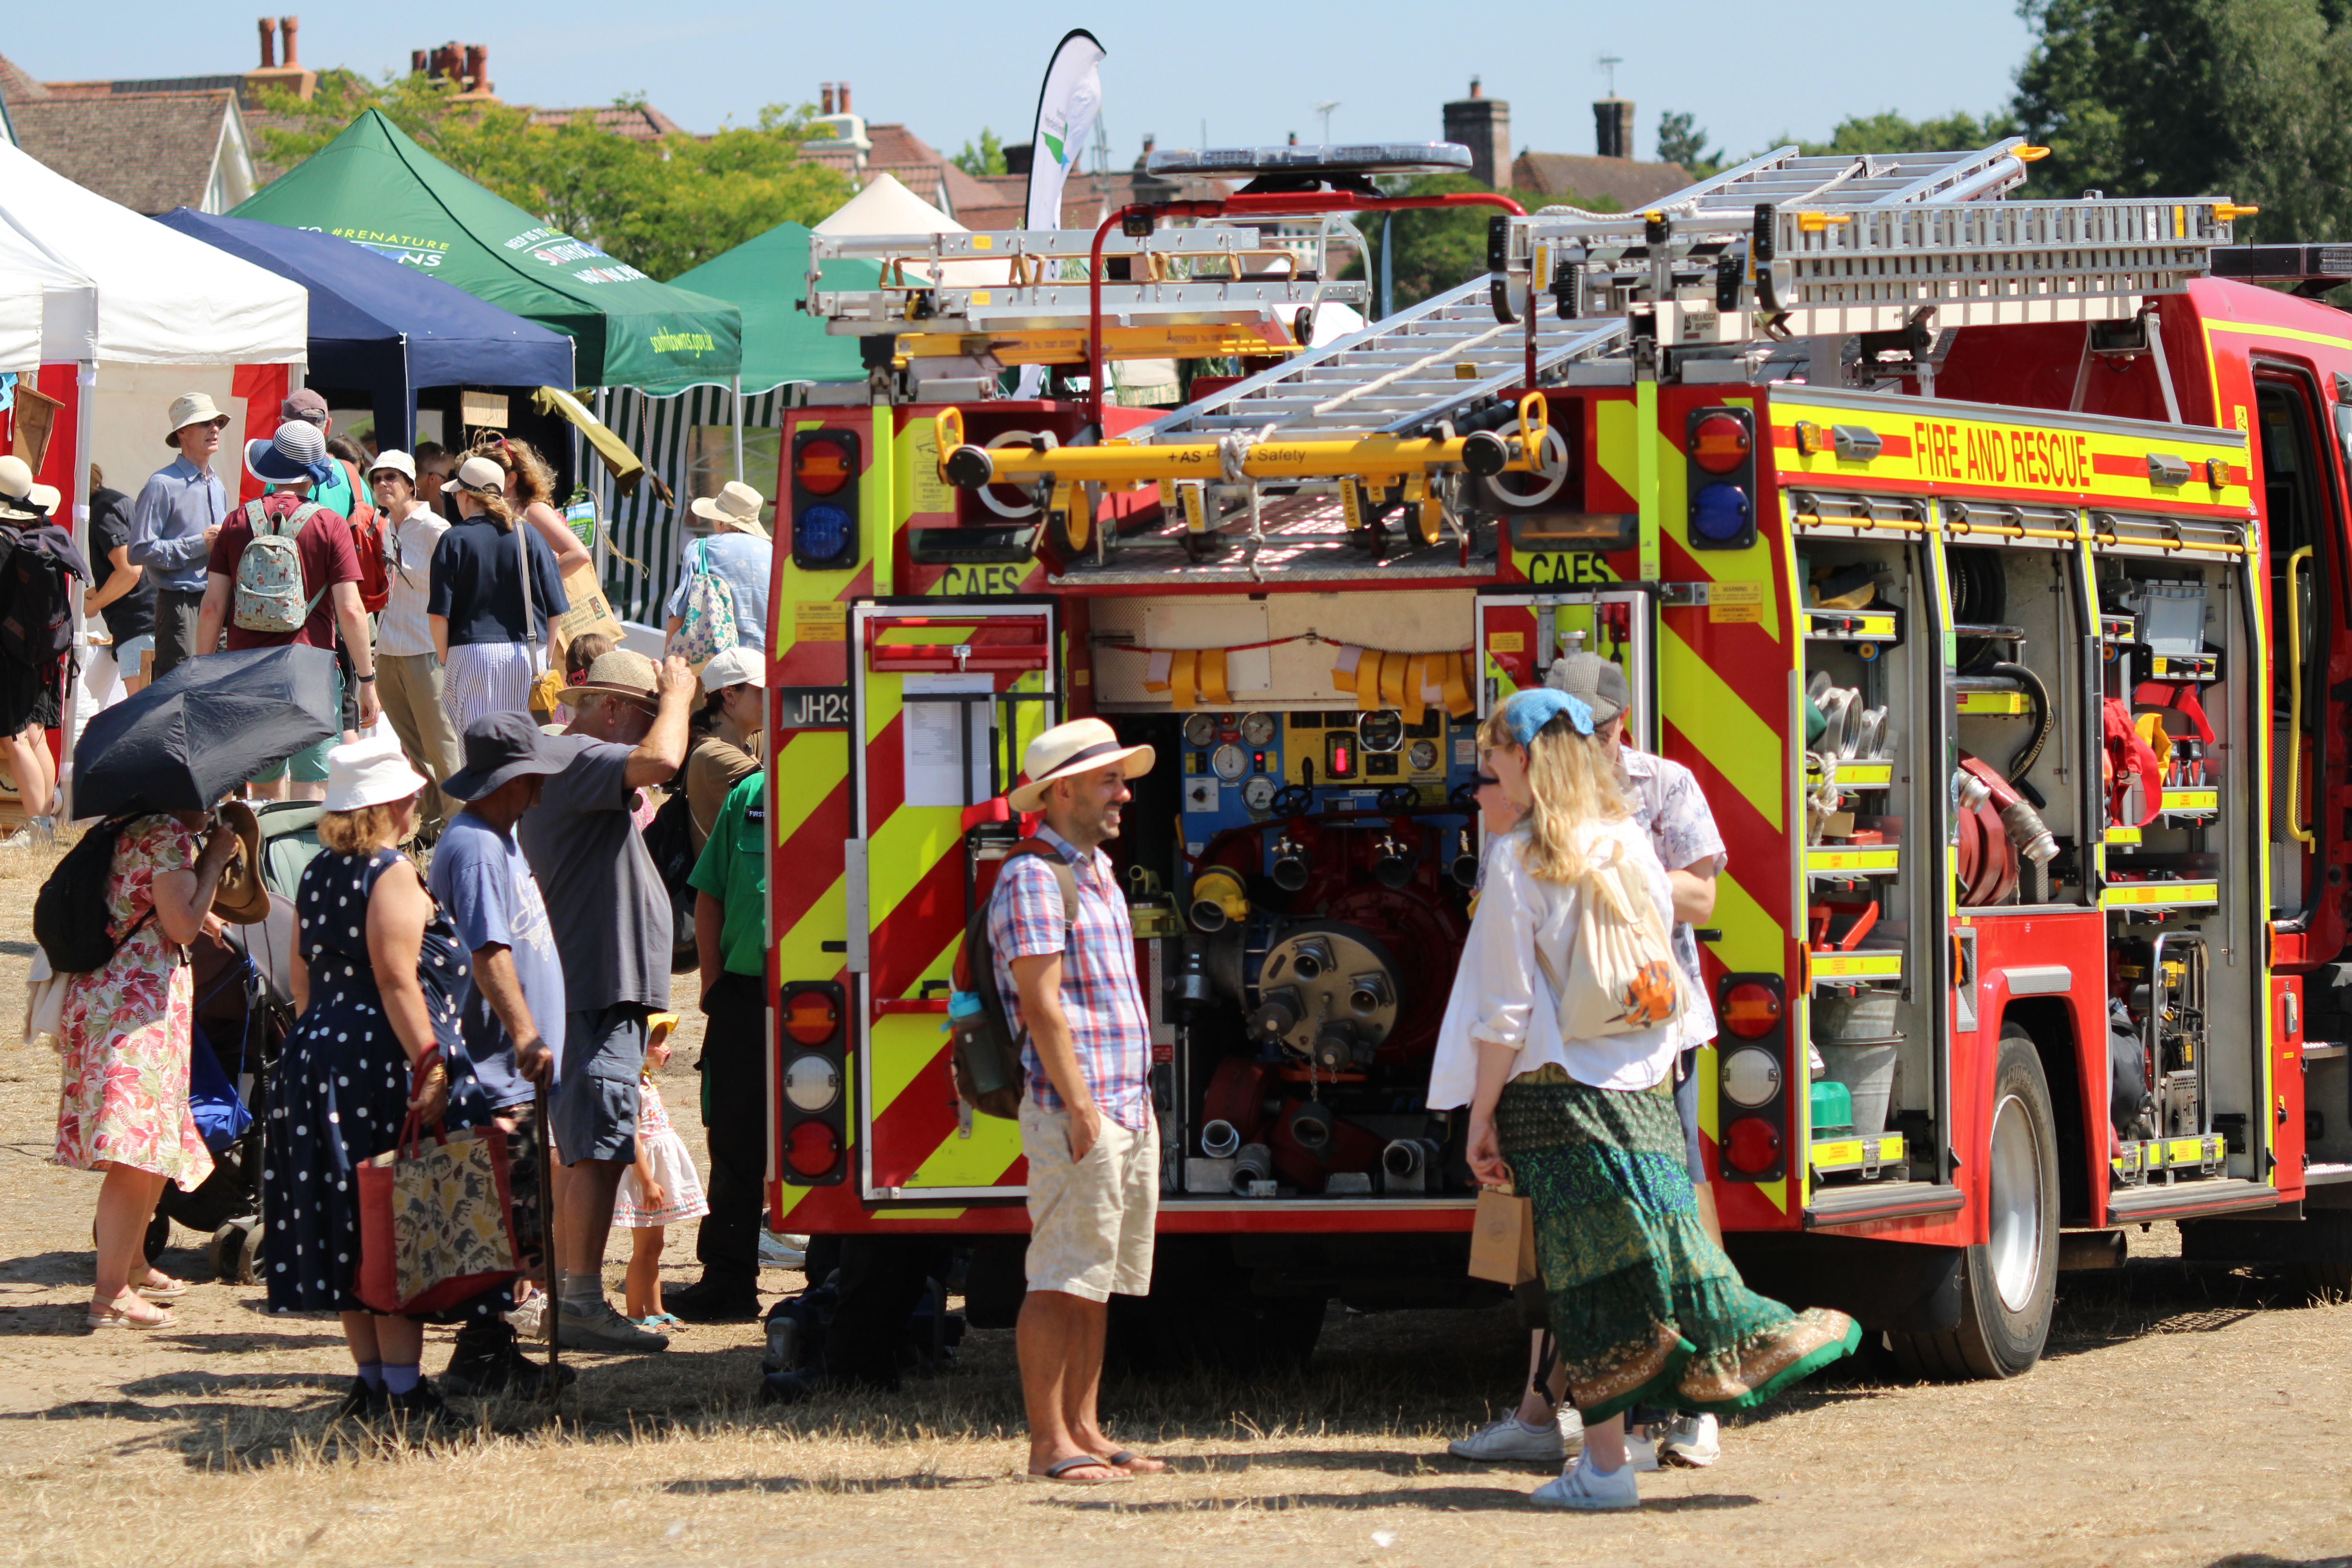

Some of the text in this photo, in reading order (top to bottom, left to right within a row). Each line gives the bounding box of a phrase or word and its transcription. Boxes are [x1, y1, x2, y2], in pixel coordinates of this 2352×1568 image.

[331, 228, 450, 250] #RENATURE
[504, 236, 529, 250] HELP
[522, 231, 540, 241] US
[532, 228, 550, 238] TO
[534, 243, 583, 266] SUTH
[650, 326, 715, 358] southdowns.gov.uk
[1180, 451, 1201, 463] AS
[1258, 448, 1307, 464] Safety
[1914, 421, 2090, 487] FIRE AND RESCUE
[1348, 507, 1356, 523] LSY
[564, 605, 582, 616] organic
[2183, 1100, 2197, 1117] HOT
